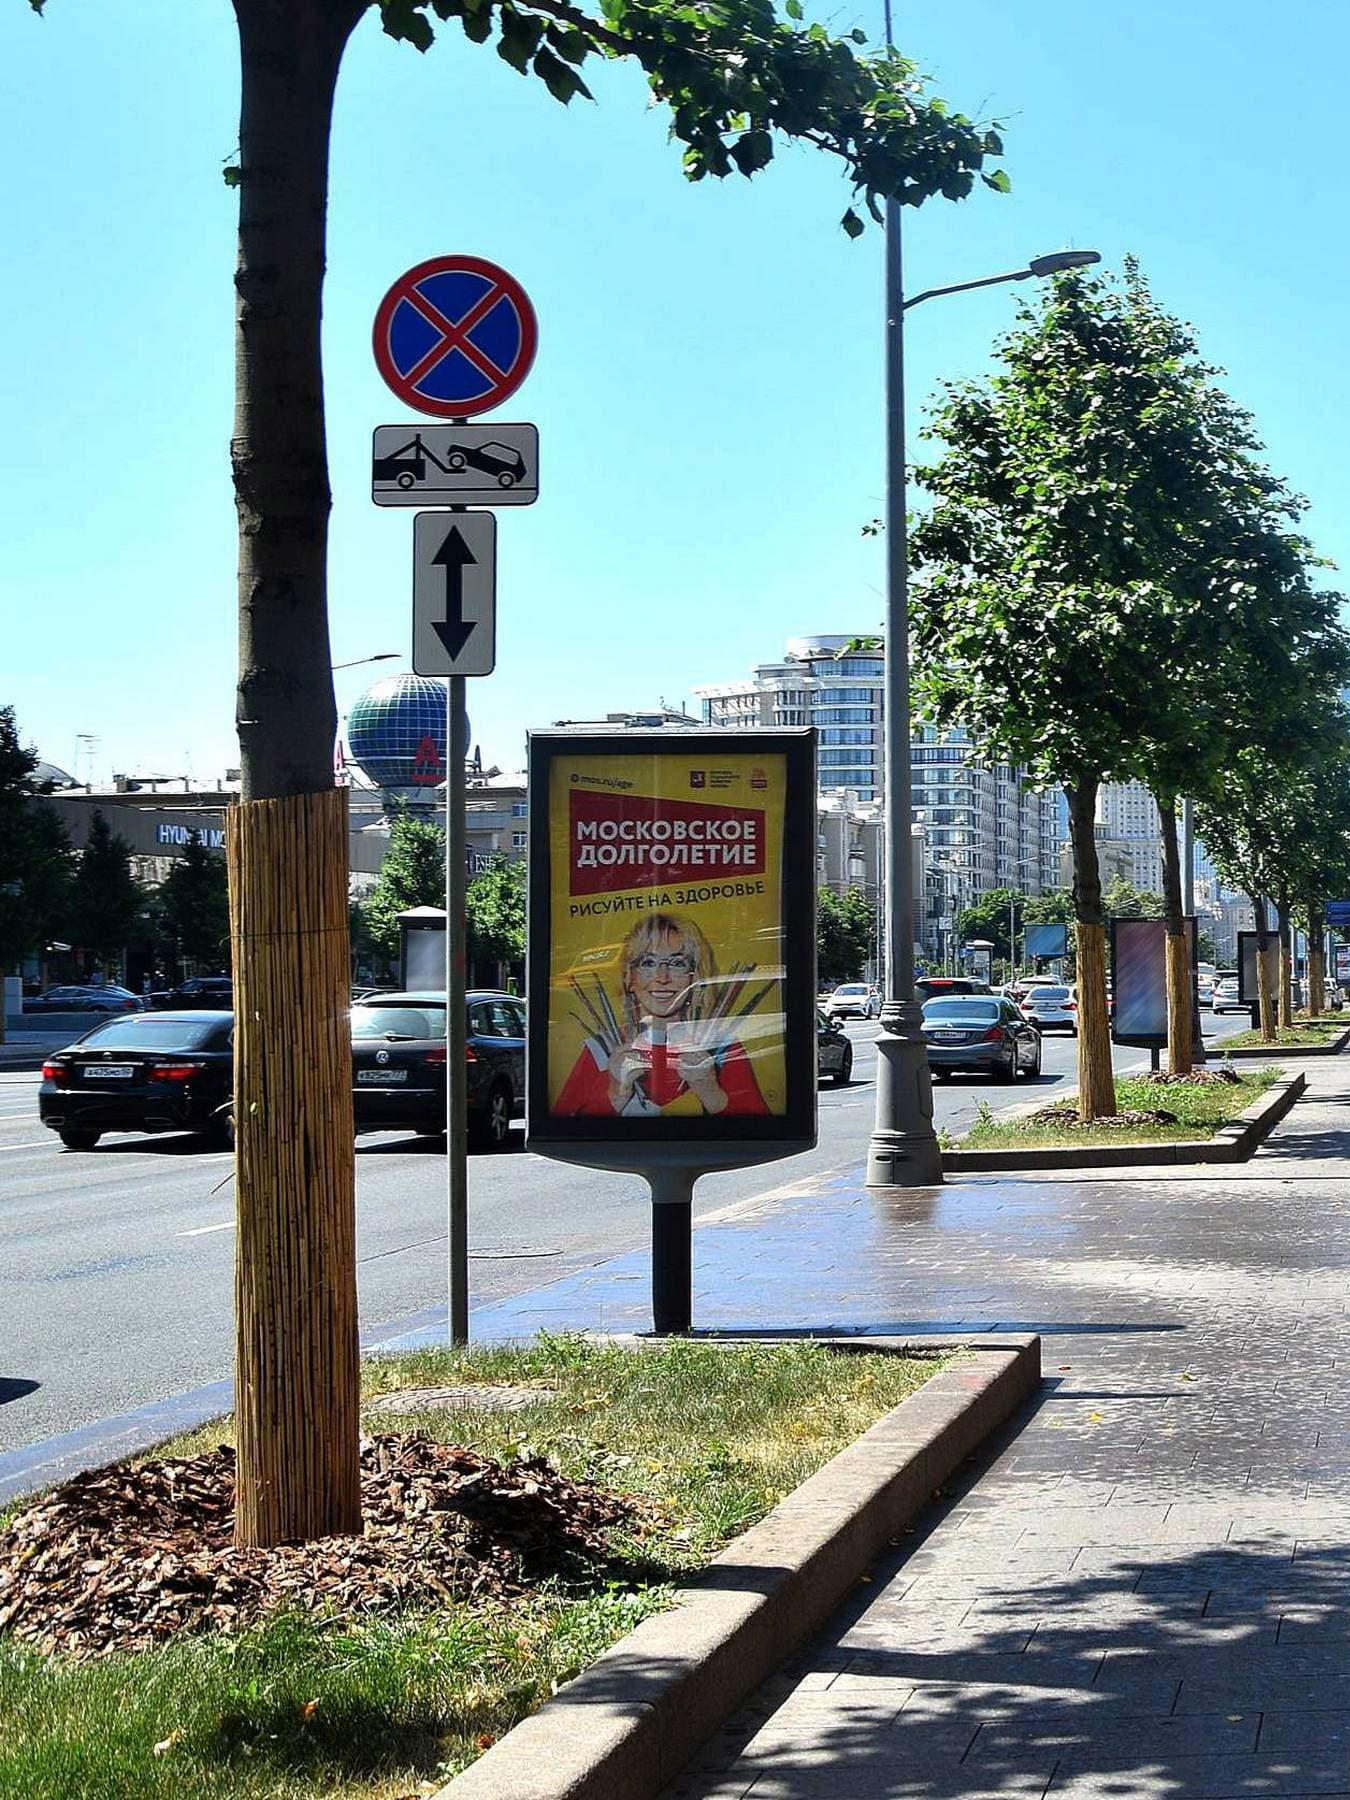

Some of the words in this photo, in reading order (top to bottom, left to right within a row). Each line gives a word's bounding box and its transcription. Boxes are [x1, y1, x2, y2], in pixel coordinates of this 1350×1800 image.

[577, 820, 757, 841] МОСКОВСКОЕ
[577, 844, 757, 868] ДОЛГОЛЕТИЕ
[569, 896, 644, 918] РИСУЙТЕ
[649, 892, 673, 908] НА
[676, 881, 765, 905] ЗДОРОВЬЕ
